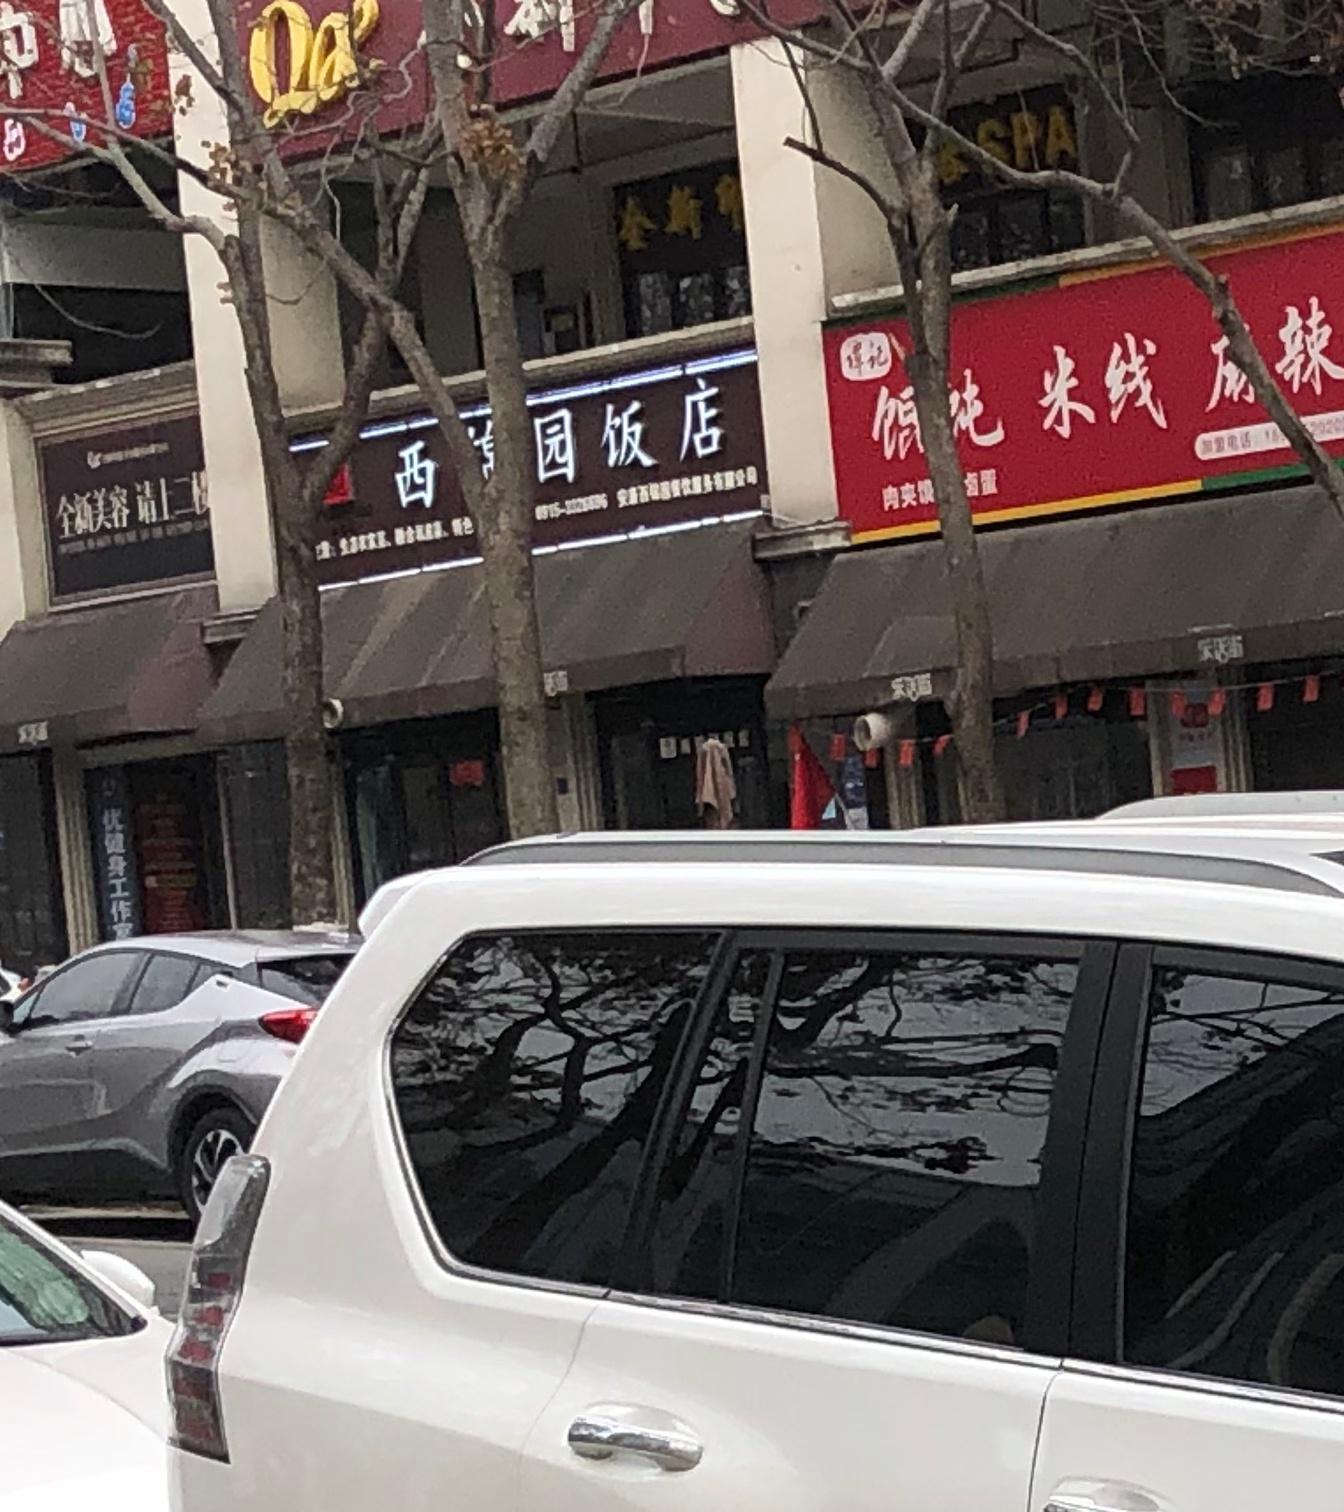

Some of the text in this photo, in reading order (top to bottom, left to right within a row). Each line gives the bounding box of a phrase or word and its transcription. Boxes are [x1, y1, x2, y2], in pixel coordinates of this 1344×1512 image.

[394, 378, 729, 509] 西园饭店
[1040, 331, 1168, 438] 米线
